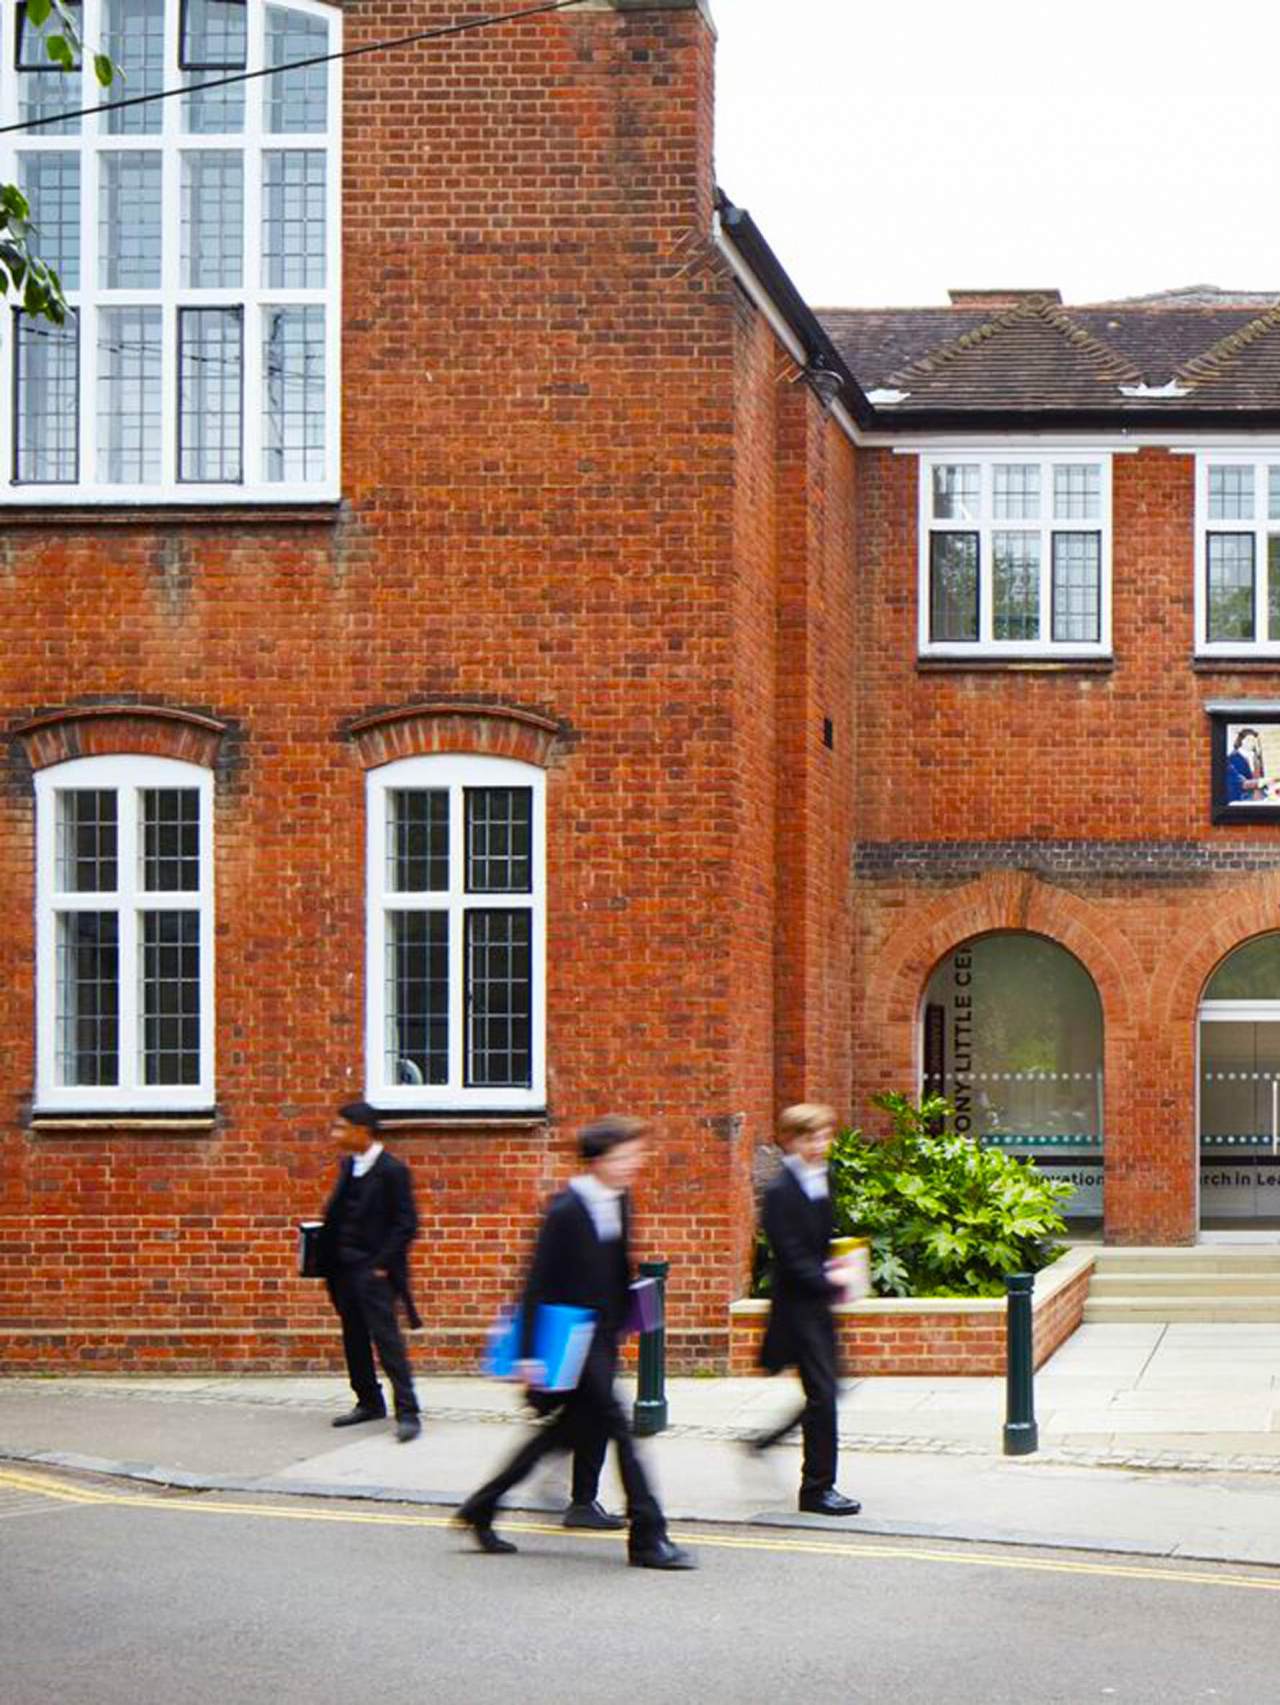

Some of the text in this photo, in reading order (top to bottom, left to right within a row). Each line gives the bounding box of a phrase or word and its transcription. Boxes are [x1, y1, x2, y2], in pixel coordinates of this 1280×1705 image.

[954, 995, 972, 1073] LITTLE
[954, 1080, 972, 1136] ONY
[1031, 1173, 1105, 1187] oation
[1235, 1171, 1251, 1185] in
